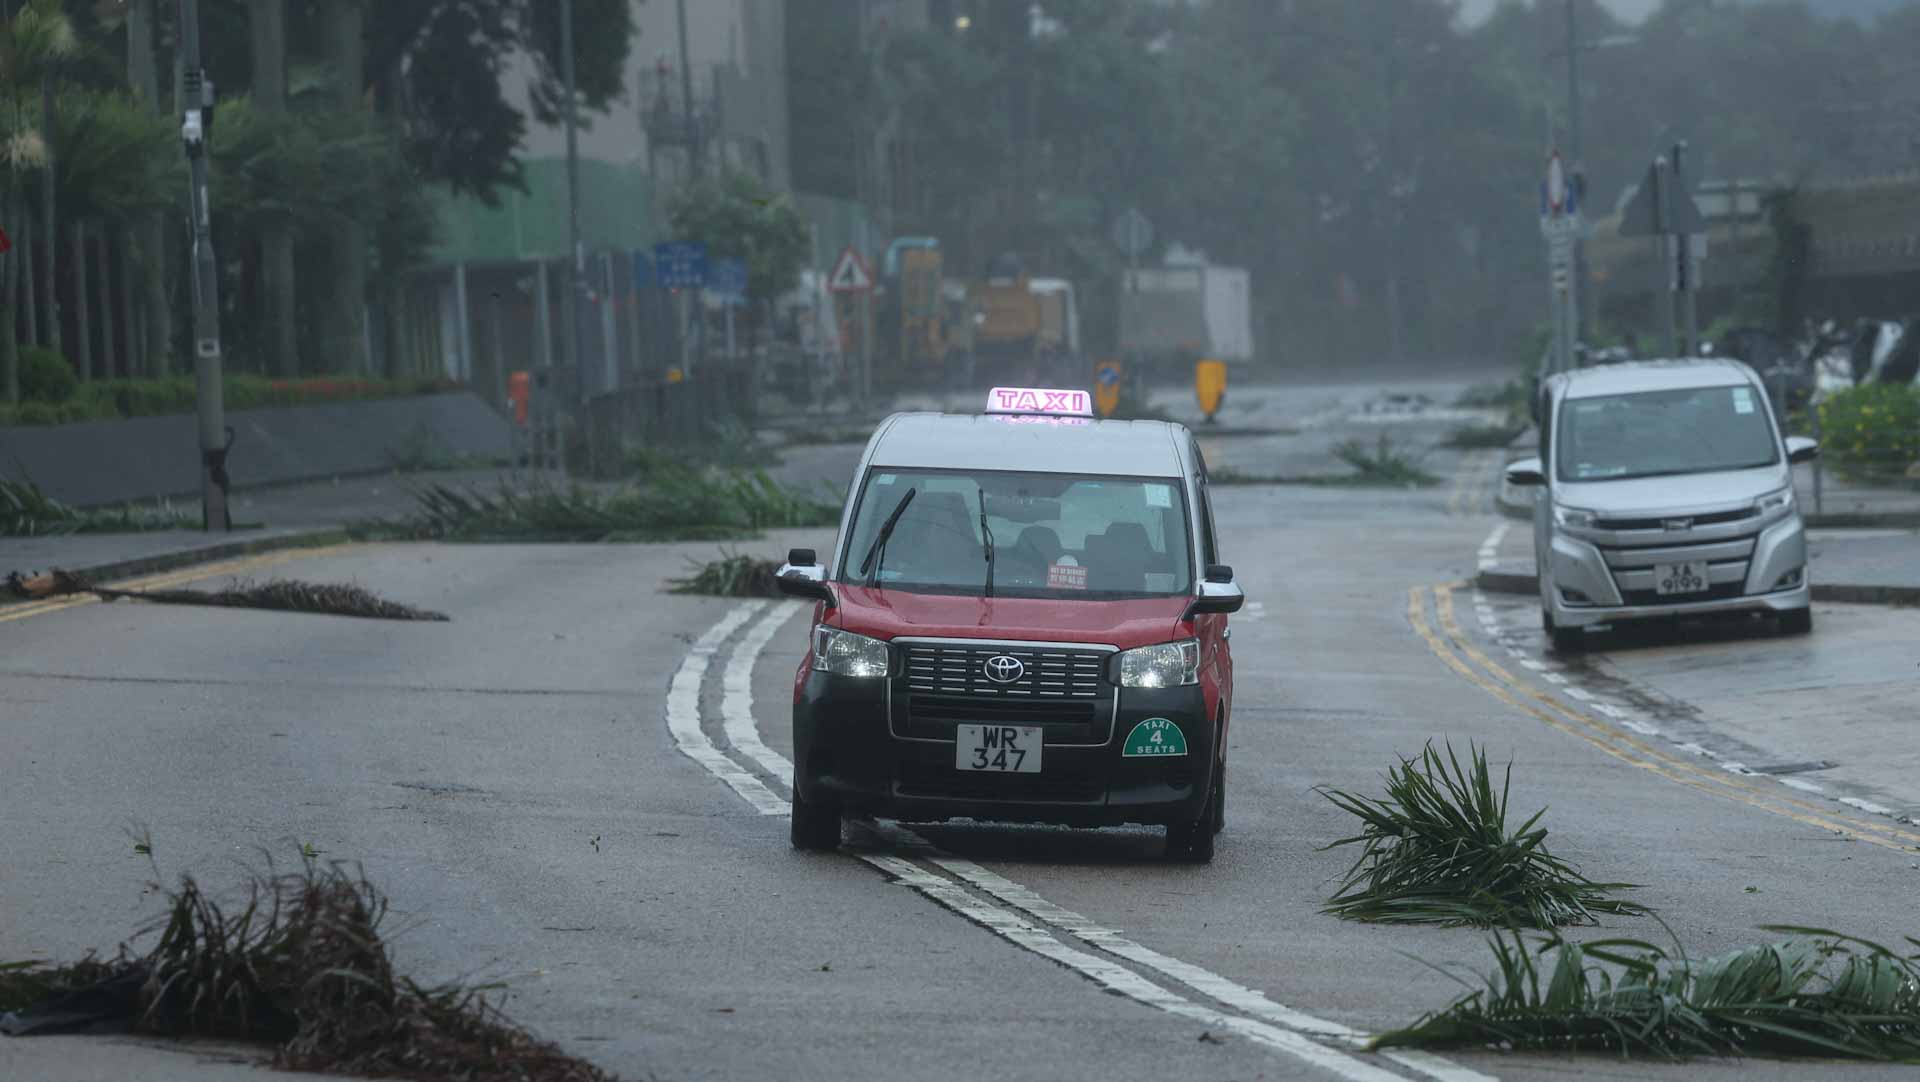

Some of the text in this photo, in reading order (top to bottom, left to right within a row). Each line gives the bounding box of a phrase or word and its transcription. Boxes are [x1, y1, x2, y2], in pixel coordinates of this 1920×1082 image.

[997, 390, 1083, 411] TAXI
[1143, 720, 1170, 730] TAXI
[982, 726, 1018, 749] WR
[1150, 729, 1163, 744] 4
[1136, 745, 1176, 754] SEATS
[972, 748, 1026, 770] 347
